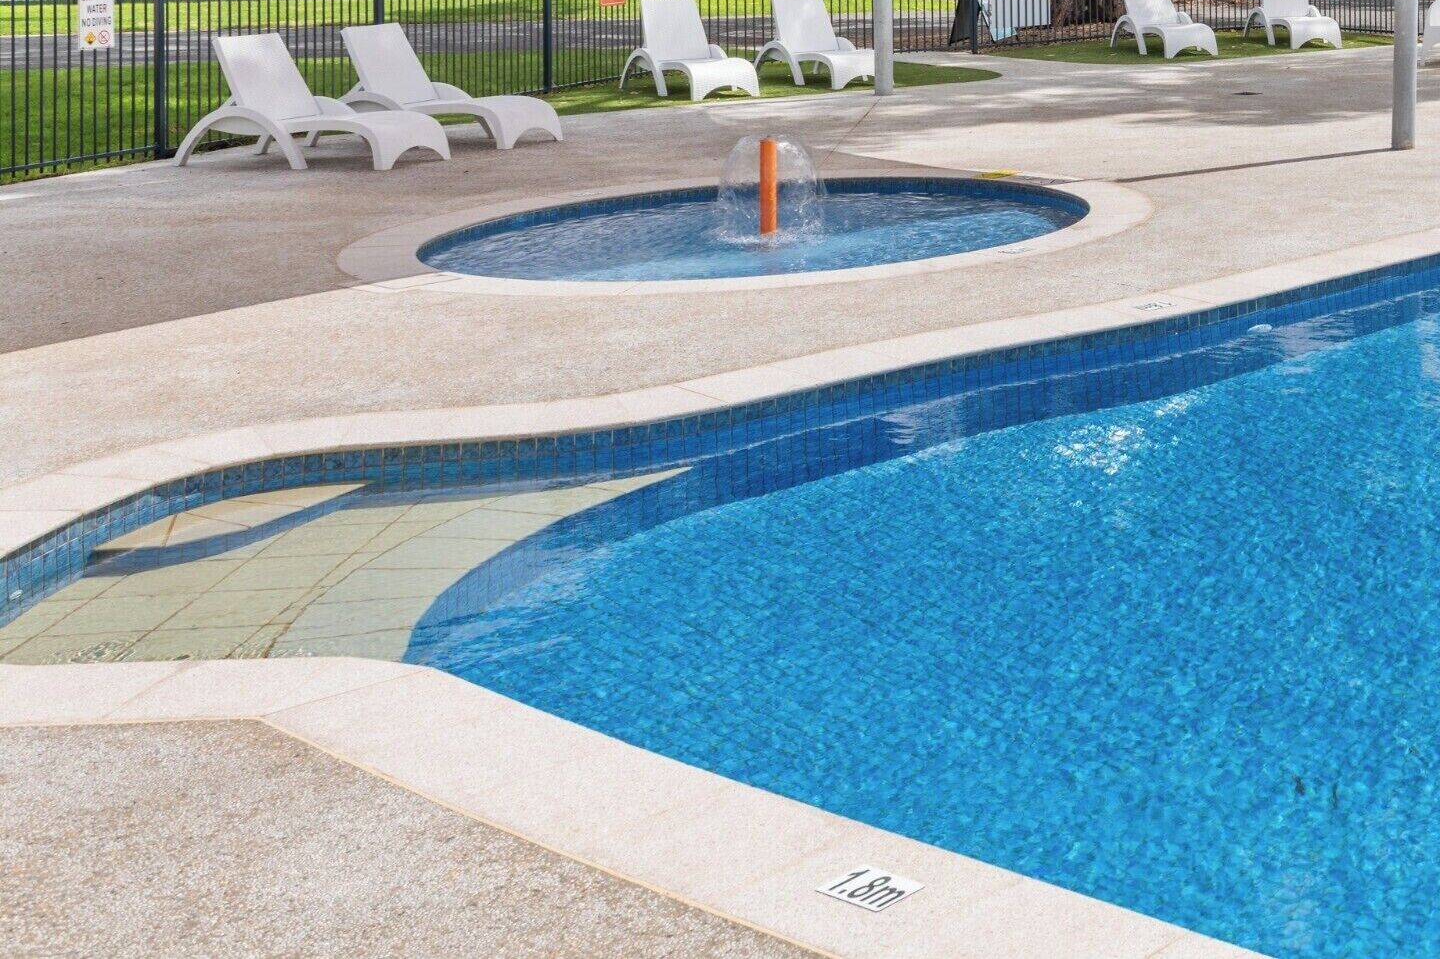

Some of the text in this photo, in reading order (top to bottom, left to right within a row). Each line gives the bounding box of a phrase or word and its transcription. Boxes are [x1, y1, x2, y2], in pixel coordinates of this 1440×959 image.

[87, 4, 107, 13] WATER
[82, 16, 112, 27] NO DIVING
[828, 869, 905, 908] 1.8m
